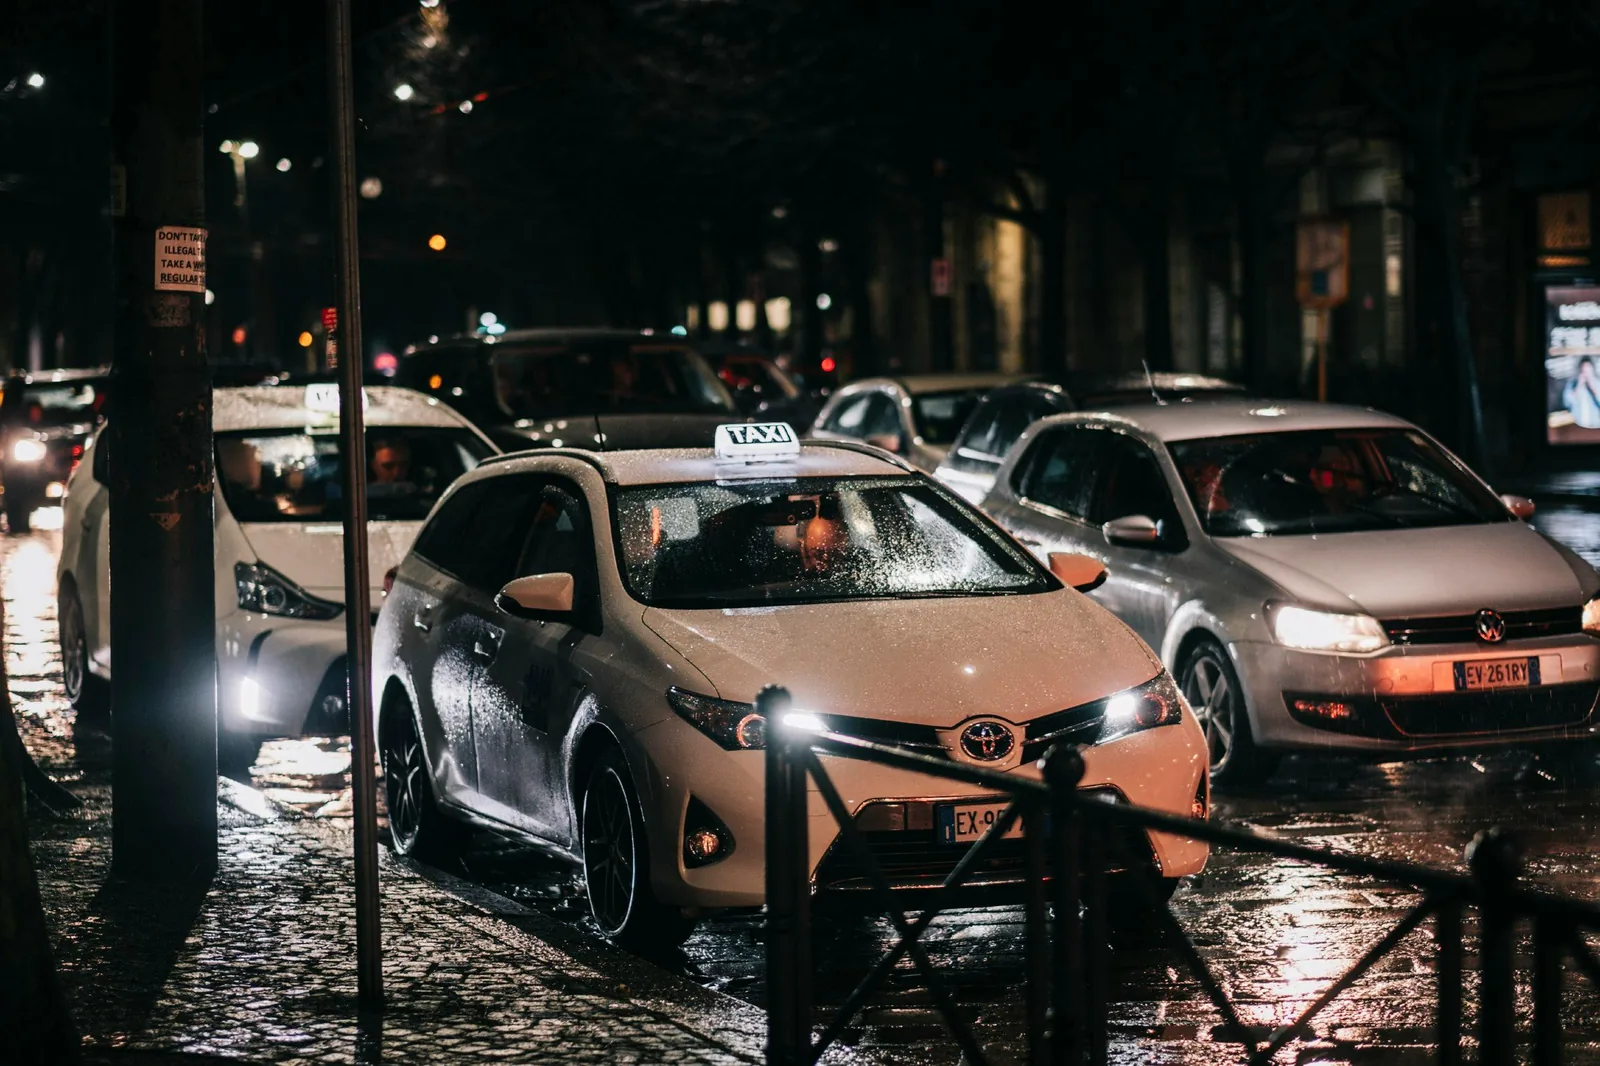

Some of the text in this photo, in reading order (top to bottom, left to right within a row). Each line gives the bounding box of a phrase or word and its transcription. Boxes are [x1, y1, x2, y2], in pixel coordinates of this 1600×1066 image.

[159, 231, 187, 240] DON'T
[165, 246, 196, 255] ILLEGAL
[161, 260, 184, 268] TAKE
[160, 274, 198, 283] REGULAR
[726, 425, 791, 443] TAXI
[1466, 666, 1483, 684] EV
[1487, 663, 1528, 683] 261RY
